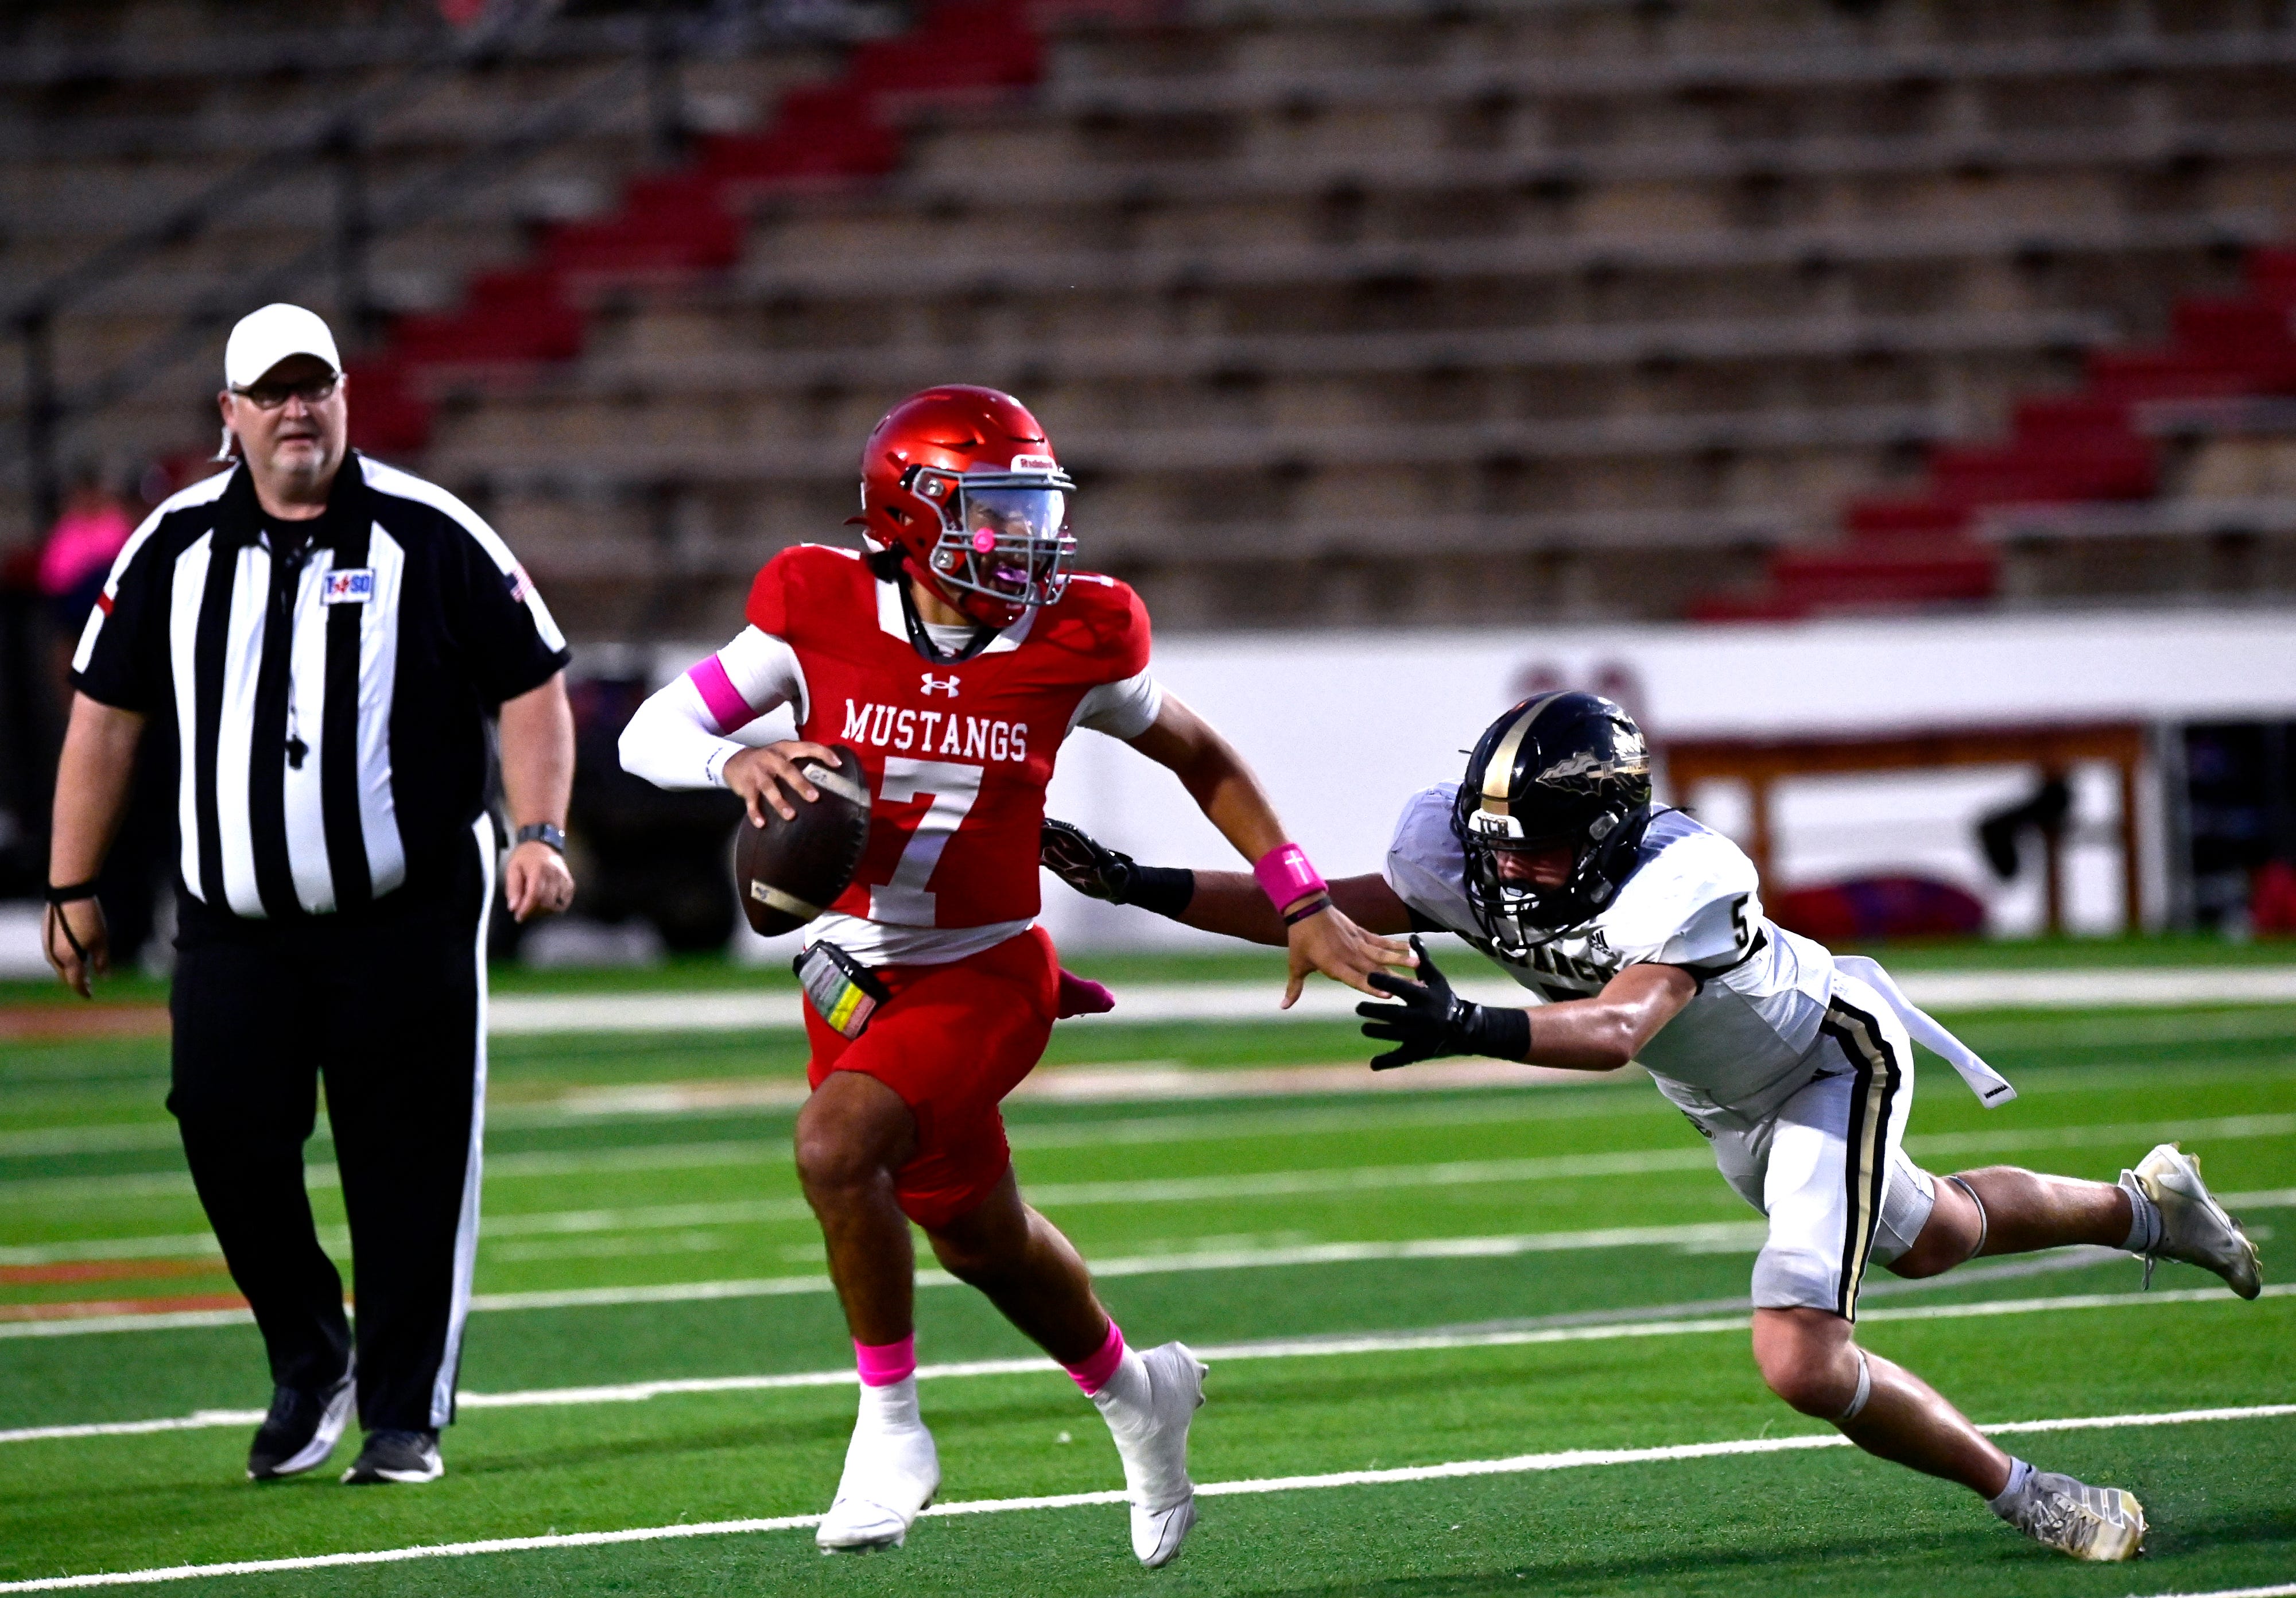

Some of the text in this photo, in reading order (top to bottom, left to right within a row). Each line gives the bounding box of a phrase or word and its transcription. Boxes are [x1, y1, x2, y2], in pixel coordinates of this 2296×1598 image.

[840, 699, 1028, 762] MUSTANGS
[867, 755, 984, 927] 7
[1731, 893, 1749, 949] 5
